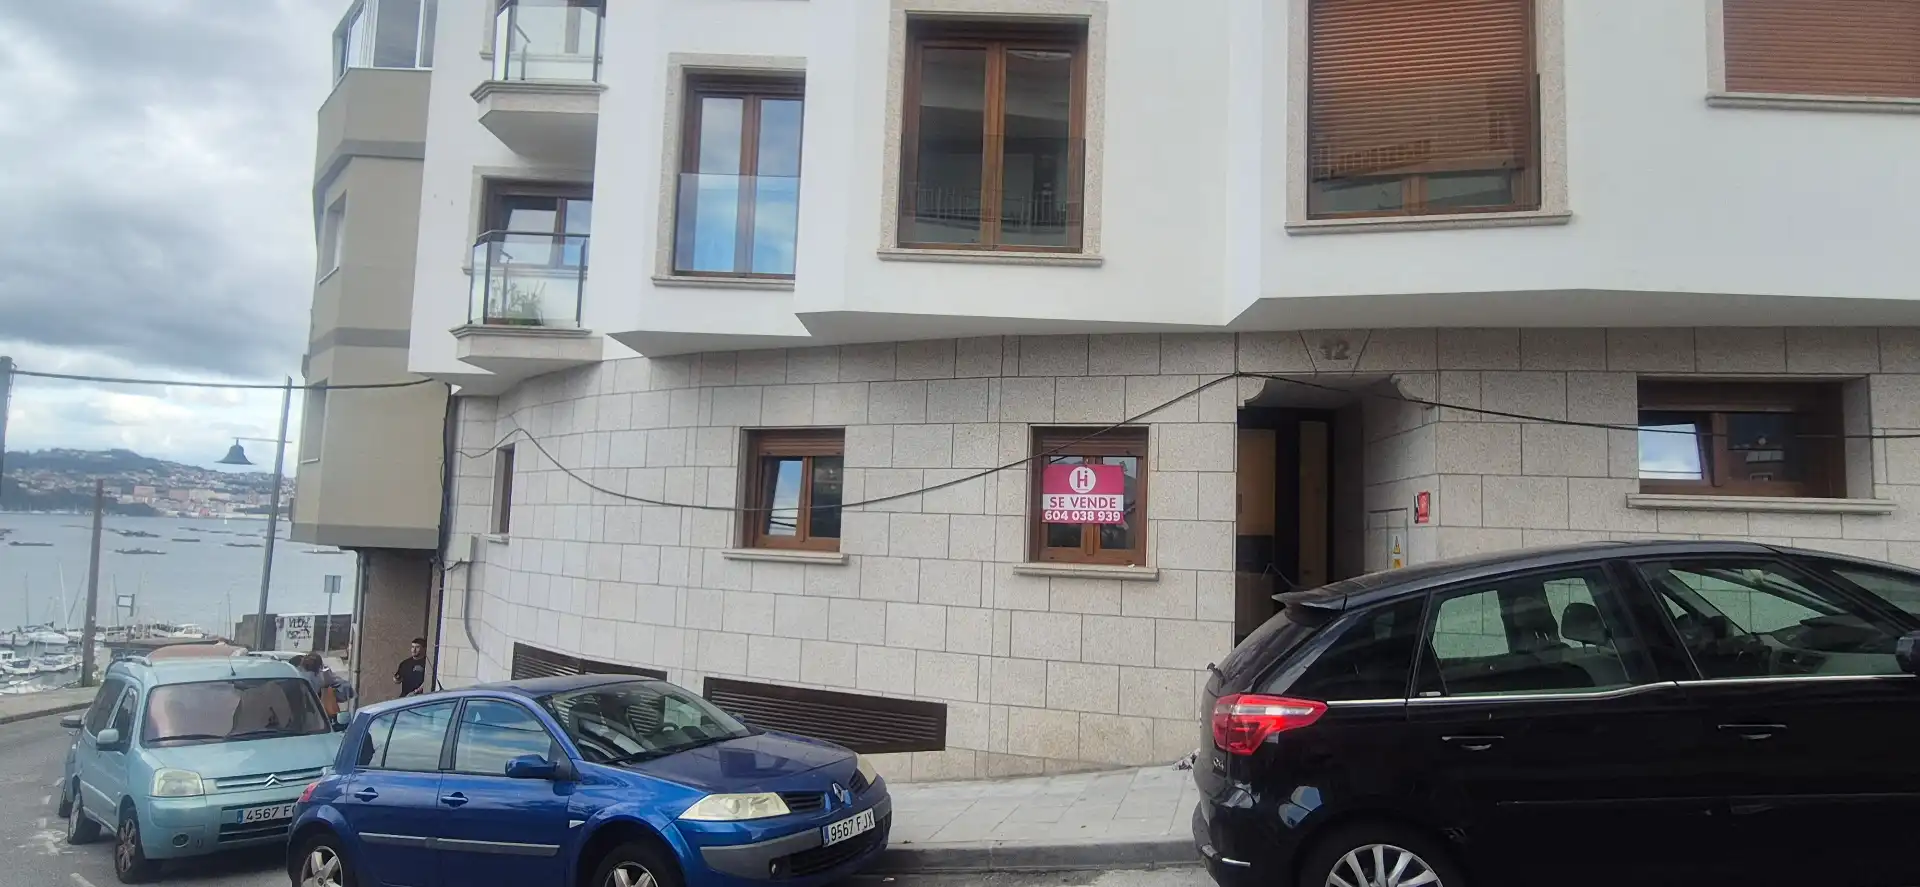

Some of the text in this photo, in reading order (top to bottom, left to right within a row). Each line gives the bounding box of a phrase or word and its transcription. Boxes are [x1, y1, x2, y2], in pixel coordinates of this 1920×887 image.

[1319, 339, 1350, 360] 12
[1049, 496, 1116, 509] SE VENDE
[1044, 510, 1121, 522] 604 038 939
[246, 806, 280, 821] 4567
[830, 810, 875, 842] 9567 FJX
